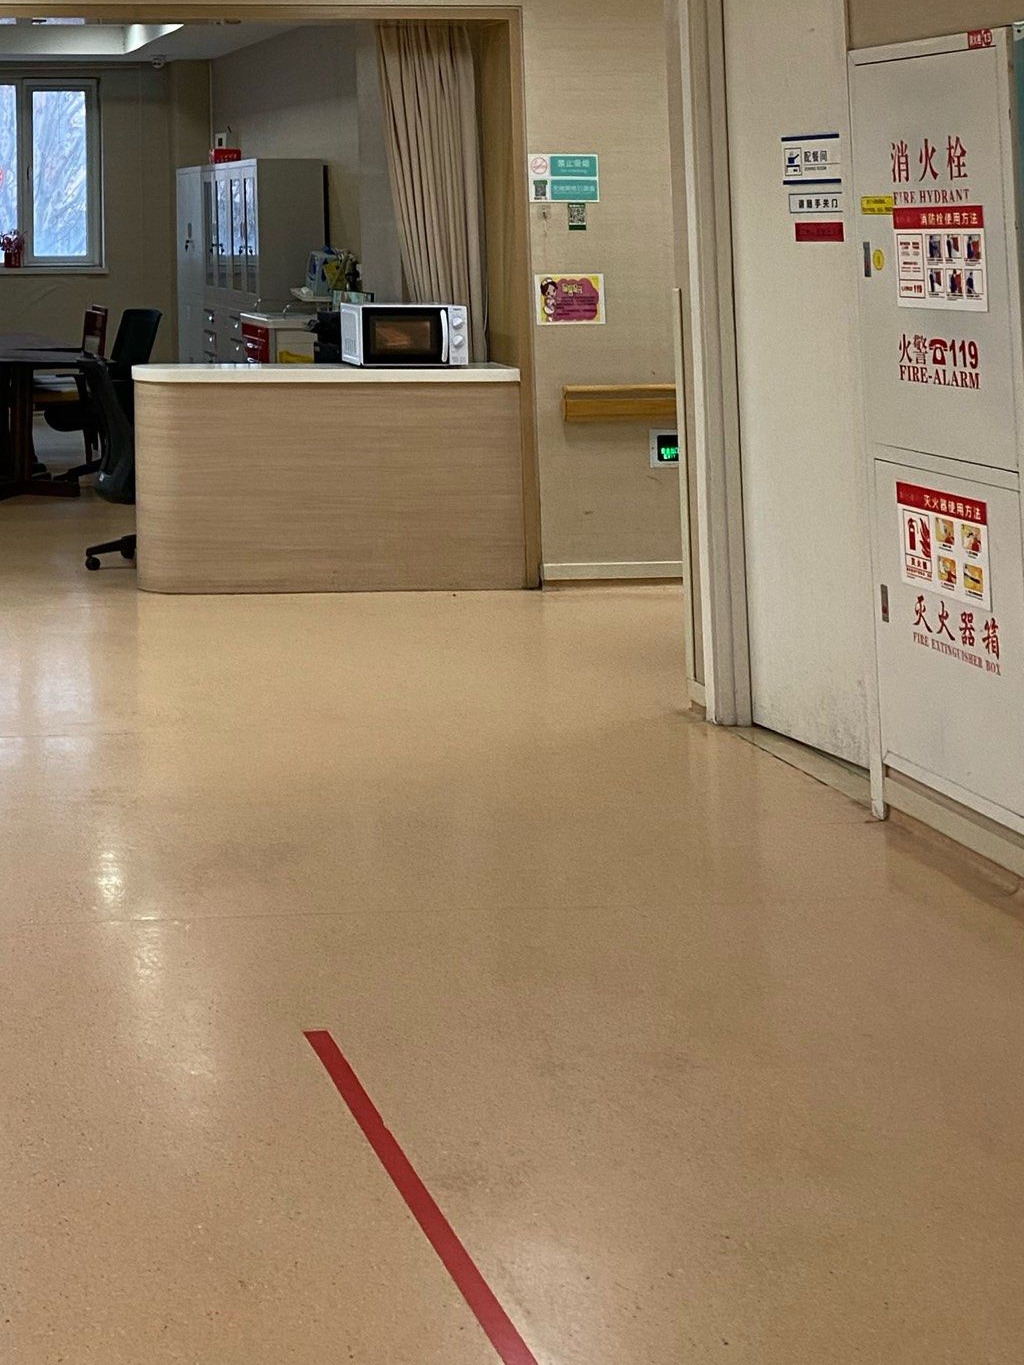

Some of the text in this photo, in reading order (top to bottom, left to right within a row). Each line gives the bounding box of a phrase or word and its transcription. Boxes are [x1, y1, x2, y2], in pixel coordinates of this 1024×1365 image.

[890, 135, 968, 183] 消火栓
[893, 191, 916, 205] FIRE
[919, 188, 969, 203] HYDRANT
[920, 212, 979, 226] 消防栓使用方法
[899, 334, 979, 370] 火警 119
[899, 364, 981, 390] FIRE-ALARM
[923, 494, 982, 520] 灭火器使用方法
[913, 595, 1001, 660] 灭火器箱
[913, 632, 1002, 676] FIRE EXTINGUISHER BOX
